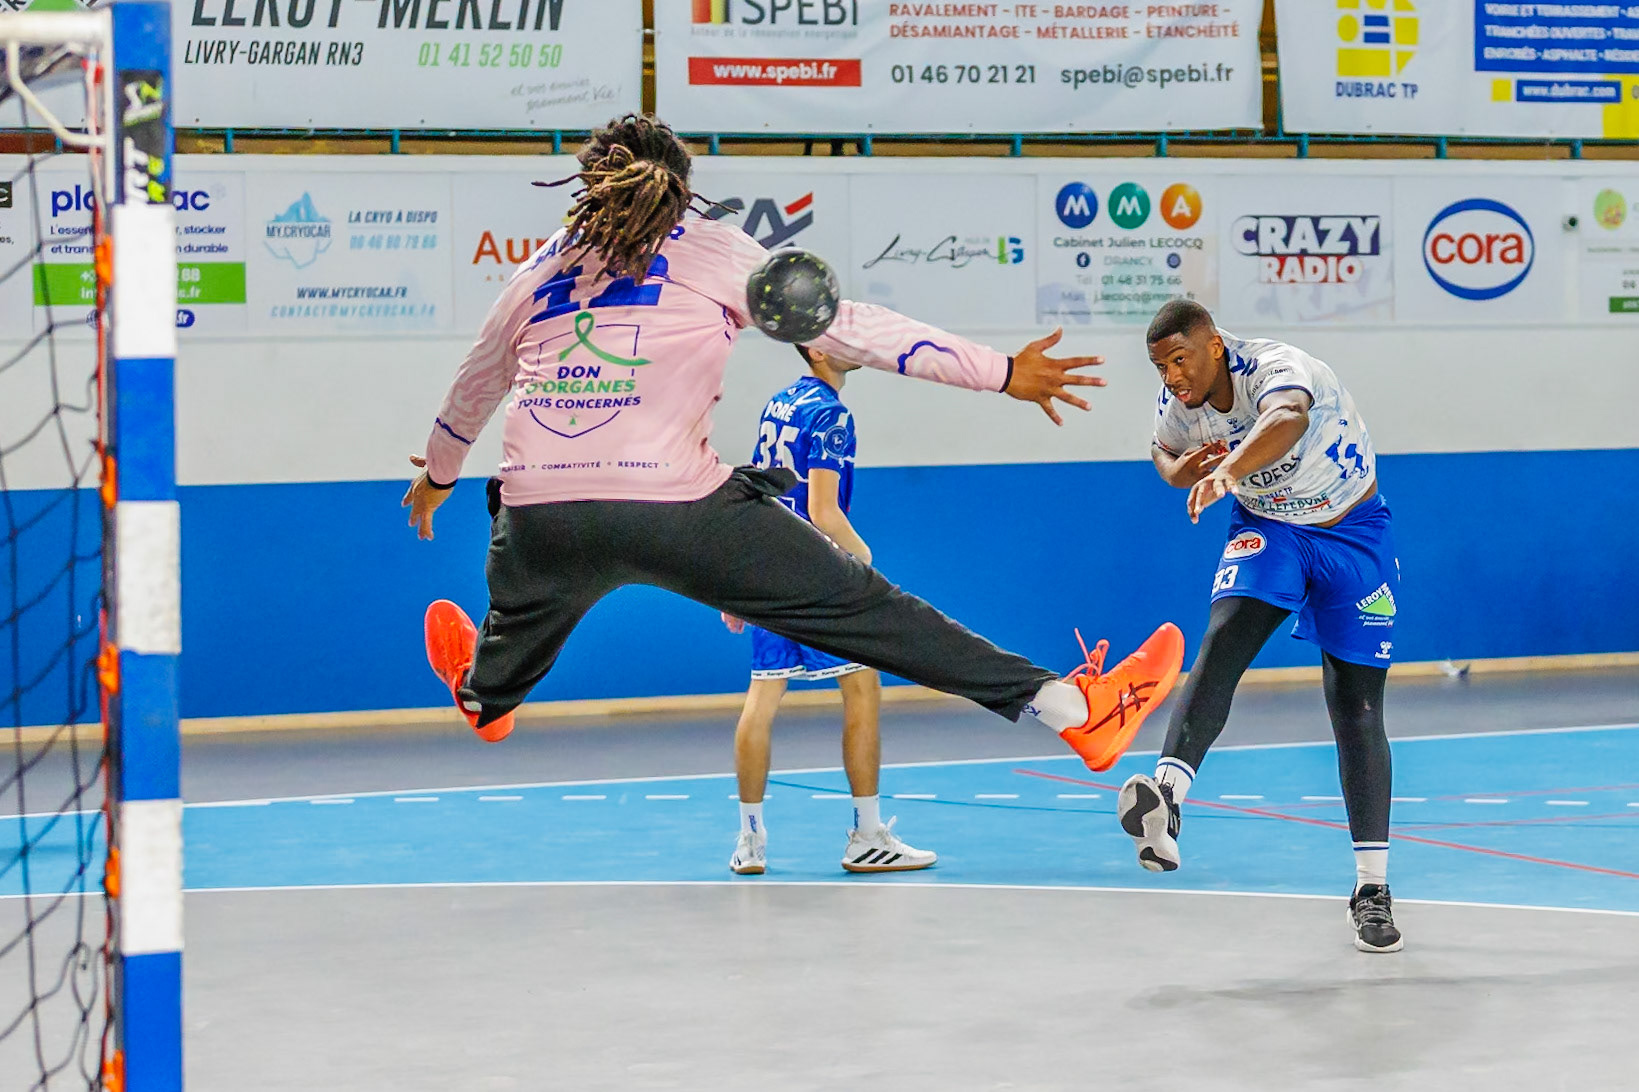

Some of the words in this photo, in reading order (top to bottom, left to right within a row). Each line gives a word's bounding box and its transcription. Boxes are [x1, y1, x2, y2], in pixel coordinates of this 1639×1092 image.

[888, 3, 998, 17] RAVALEMENT
[1015, 4, 1037, 18] ITE
[1054, 5, 1129, 19] BARDAGE
[1147, 4, 1218, 18] PEINTURE
[889, 20, 1019, 39] DÉSAMIANTAGE
[1036, 21, 1129, 40] MÉTALLERIE
[184, 40, 320, 65] LIVRY-GARGAN
[326, 42, 364, 66] RN3
[417, 42, 440, 66] 01
[448, 43, 471, 66] 41
[479, 43, 503, 67] 52
[508, 44, 533, 68] 50
[538, 44, 563, 68] 50
[712, 62, 838, 83] www.spebi.fr
[890, 65, 913, 84] 01
[920, 65, 948, 84] 46
[954, 65, 981, 84] 70
[987, 65, 1008, 84] 21
[1014, 65, 1036, 84] 21
[1060, 63, 1234, 90] spebi@spebi.fr
[1335, 81, 1396, 98] DUBRAC
[1401, 83, 1419, 98] TP
[1063, 194, 1091, 217] M
[1116, 195, 1142, 216] M
[1170, 195, 1192, 218] A
[184, 225, 226, 235] stocker
[1231, 214, 1380, 256] CRAZY
[183, 244, 229, 254] durable
[1053, 236, 1104, 248] Cabinet
[1106, 237, 1146, 248] Julien
[1149, 238, 1204, 250] LECOCQ
[1430, 232, 1524, 264] cora
[1259, 254, 1364, 283] RADIO
[556, 365, 601, 379] DON
[554, 394, 641, 409] CONCERNÉS
[540, 460, 602, 471] COMBATIVITÉ
[617, 460, 660, 469] RESPECT
[1226, 536, 1261, 554] cora
[1355, 587, 1384, 611] LEROY
